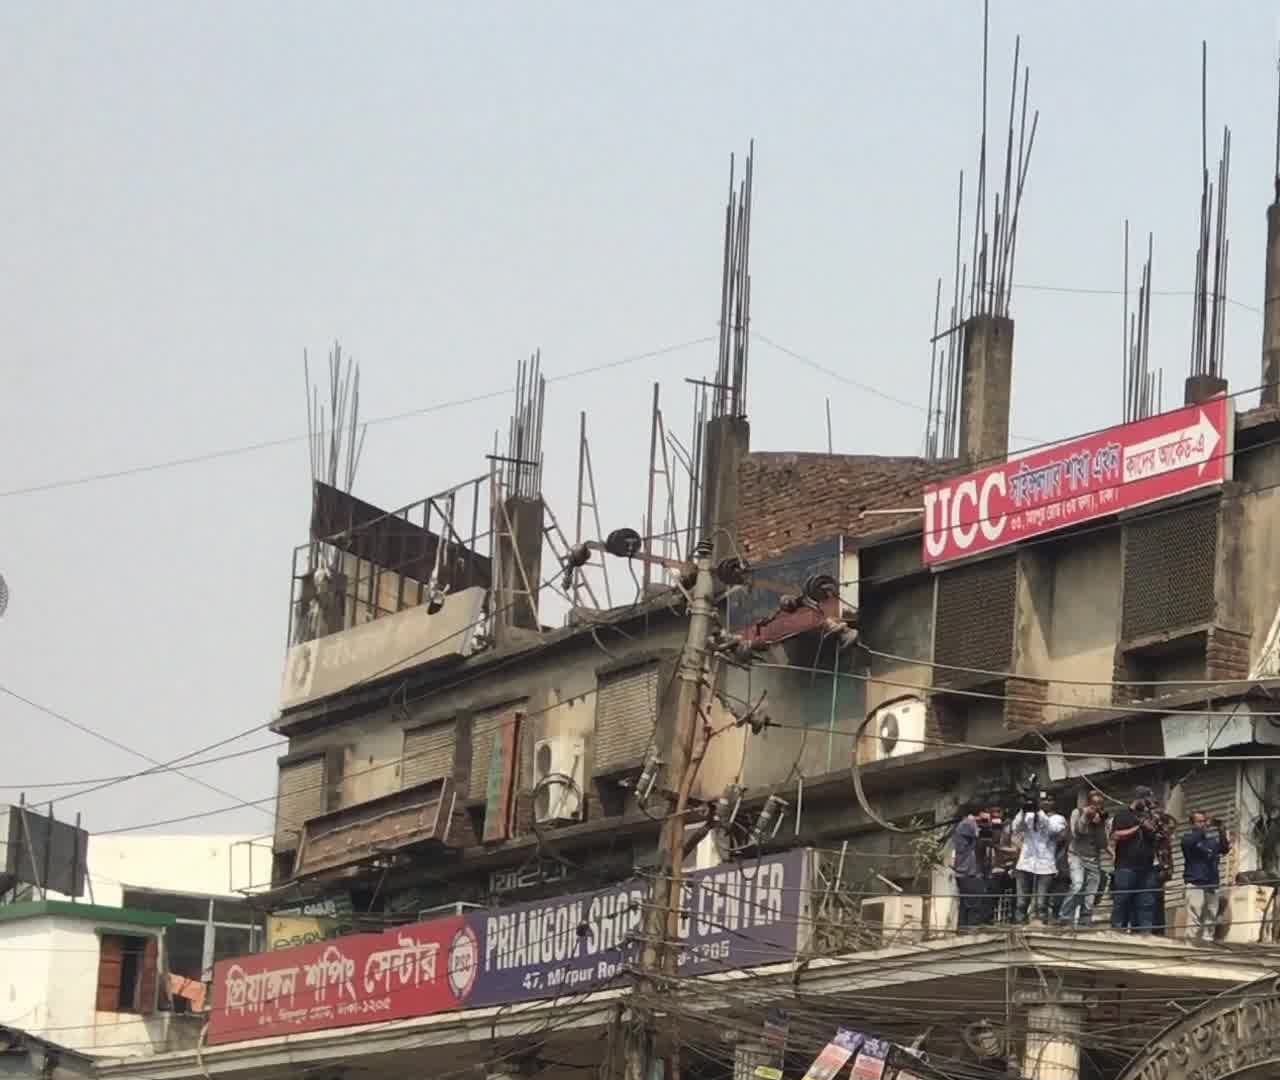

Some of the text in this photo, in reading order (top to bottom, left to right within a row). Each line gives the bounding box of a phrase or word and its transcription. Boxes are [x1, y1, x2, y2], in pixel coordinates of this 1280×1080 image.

[924, 471, 1008, 558] UCC
[486, 862, 786, 973] PRIANGON SHOPG CENTER
[304, 945, 356, 1002] শপিং
[364, 932, 440, 994] সেন্টার
[547, 963, 594, 989] Mirpur
